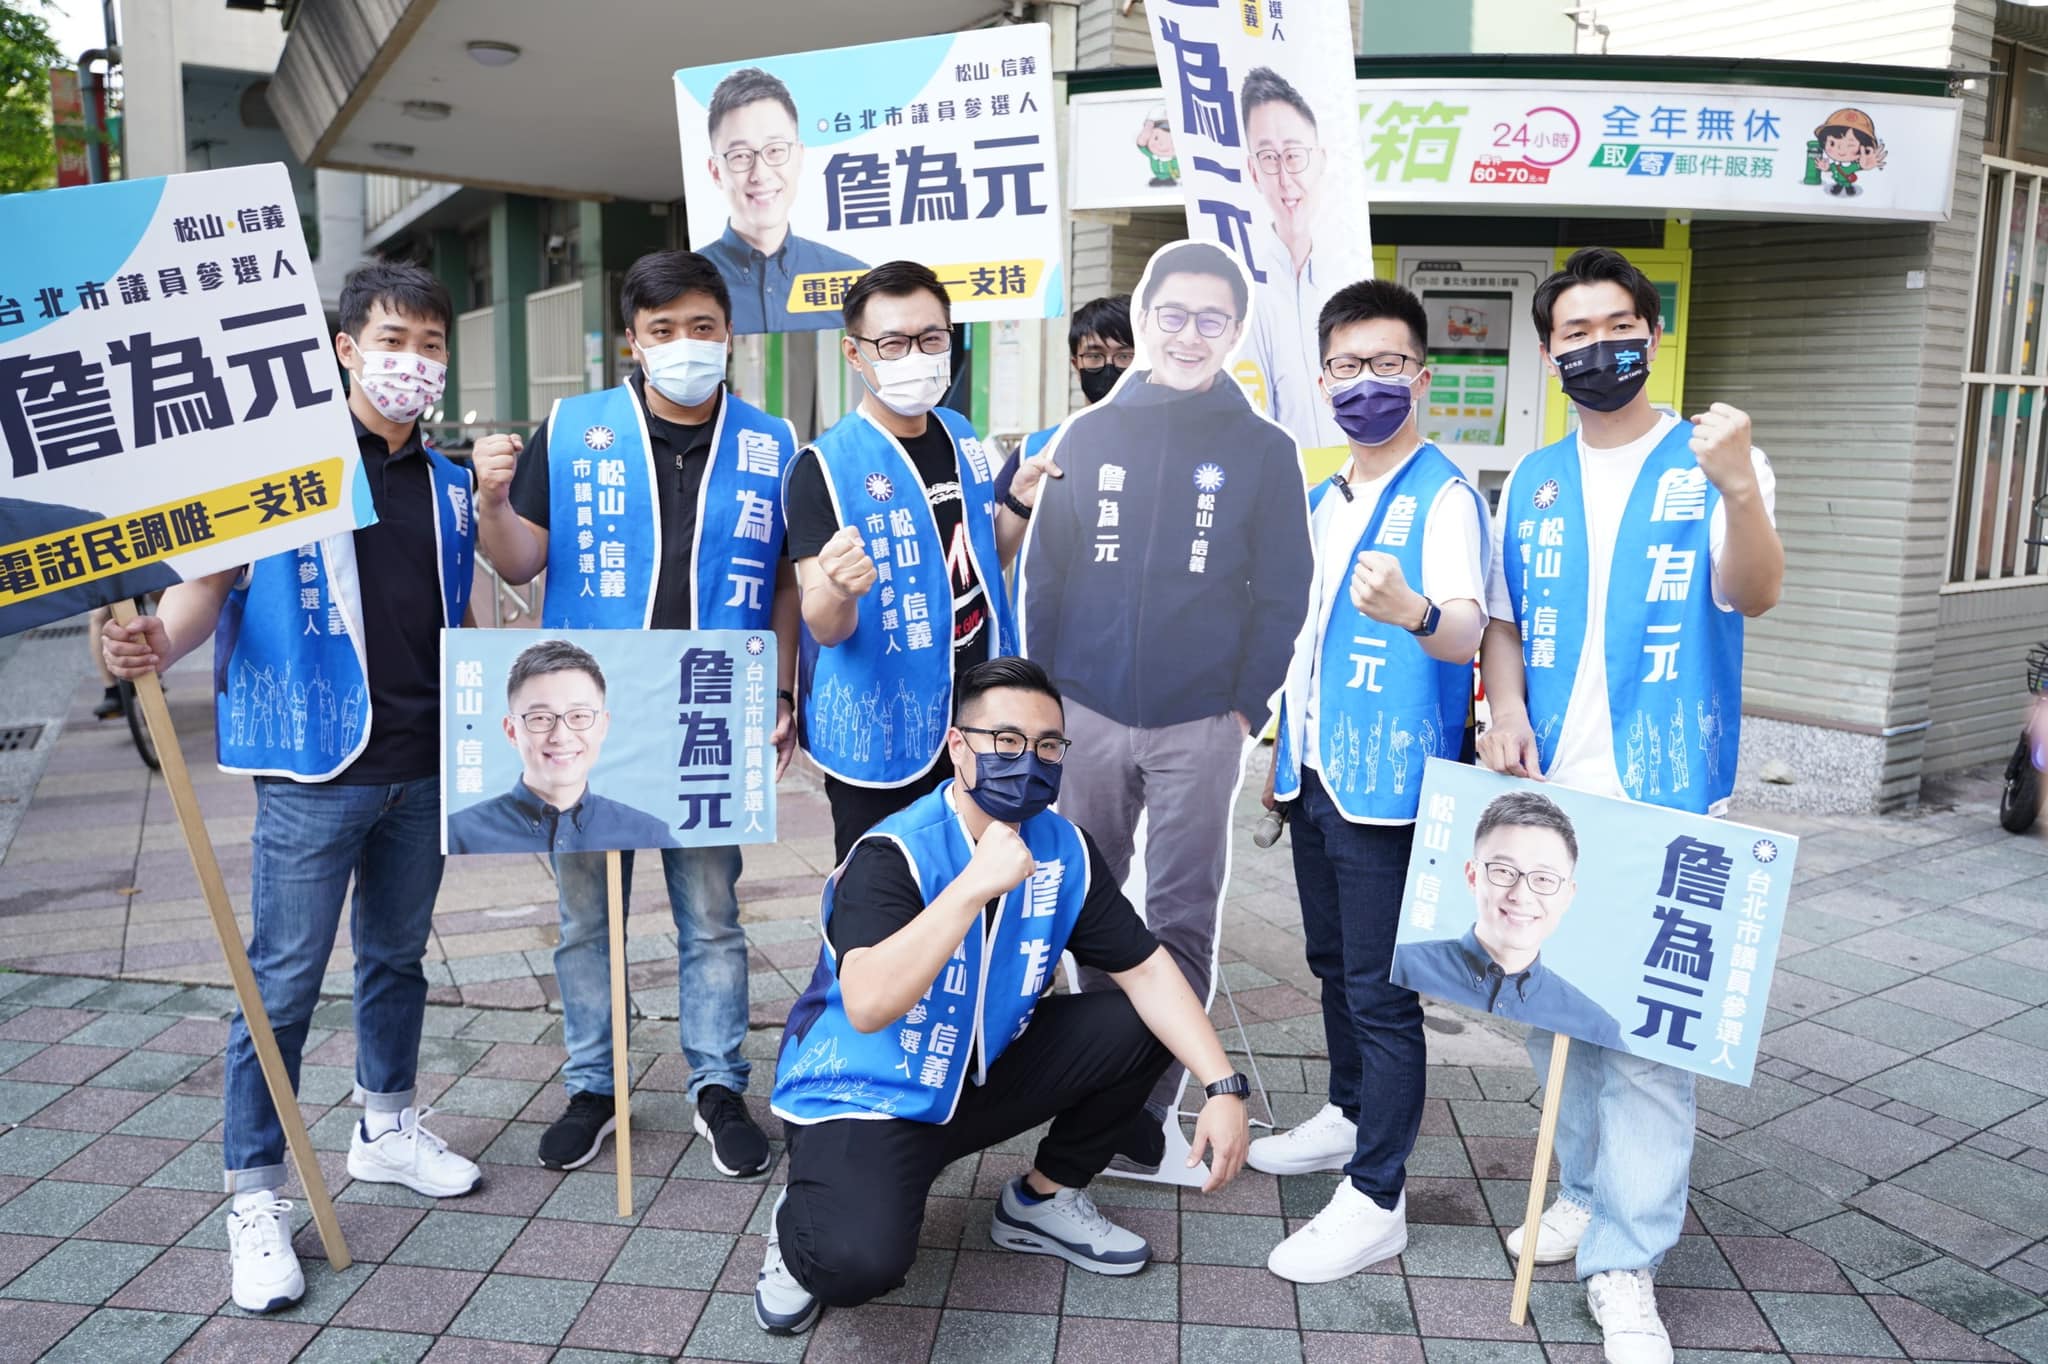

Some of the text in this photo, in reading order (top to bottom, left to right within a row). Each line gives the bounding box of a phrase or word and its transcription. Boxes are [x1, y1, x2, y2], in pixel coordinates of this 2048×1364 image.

[823, 135, 1048, 232] 詹為元
[833, 91, 1039, 133] 台北市議員參選人
[1158, 0, 1268, 284] 為元
[1601, 145, 1774, 179] 取寄郵件服務
[1602, 105, 1781, 143] 全年無休
[0, 249, 298, 327] 台北市議員參選人
[0, 303, 333, 479] 詹為元
[0, 469, 328, 595] 電話民調唯一支持
[572, 458, 596, 598] 市議員參選人
[597, 459, 627, 599] 松山·信義
[724, 428, 780, 610] 詹為元
[865, 513, 902, 655] 市議員參選人
[889, 507, 934, 651] 松山·信義
[1093, 463, 1127, 562] 詹為元
[1642, 467, 1708, 684] 詹為元
[1346, 494, 1418, 693] 詹元
[1530, 517, 1565, 669] 松山·信義
[678, 647, 735, 831] 詹為元
[743, 663, 765, 833] 台北市議員參選人
[1631, 834, 1734, 1052] 詹為元
[1710, 868, 1773, 1071] 台北市議員參選人
